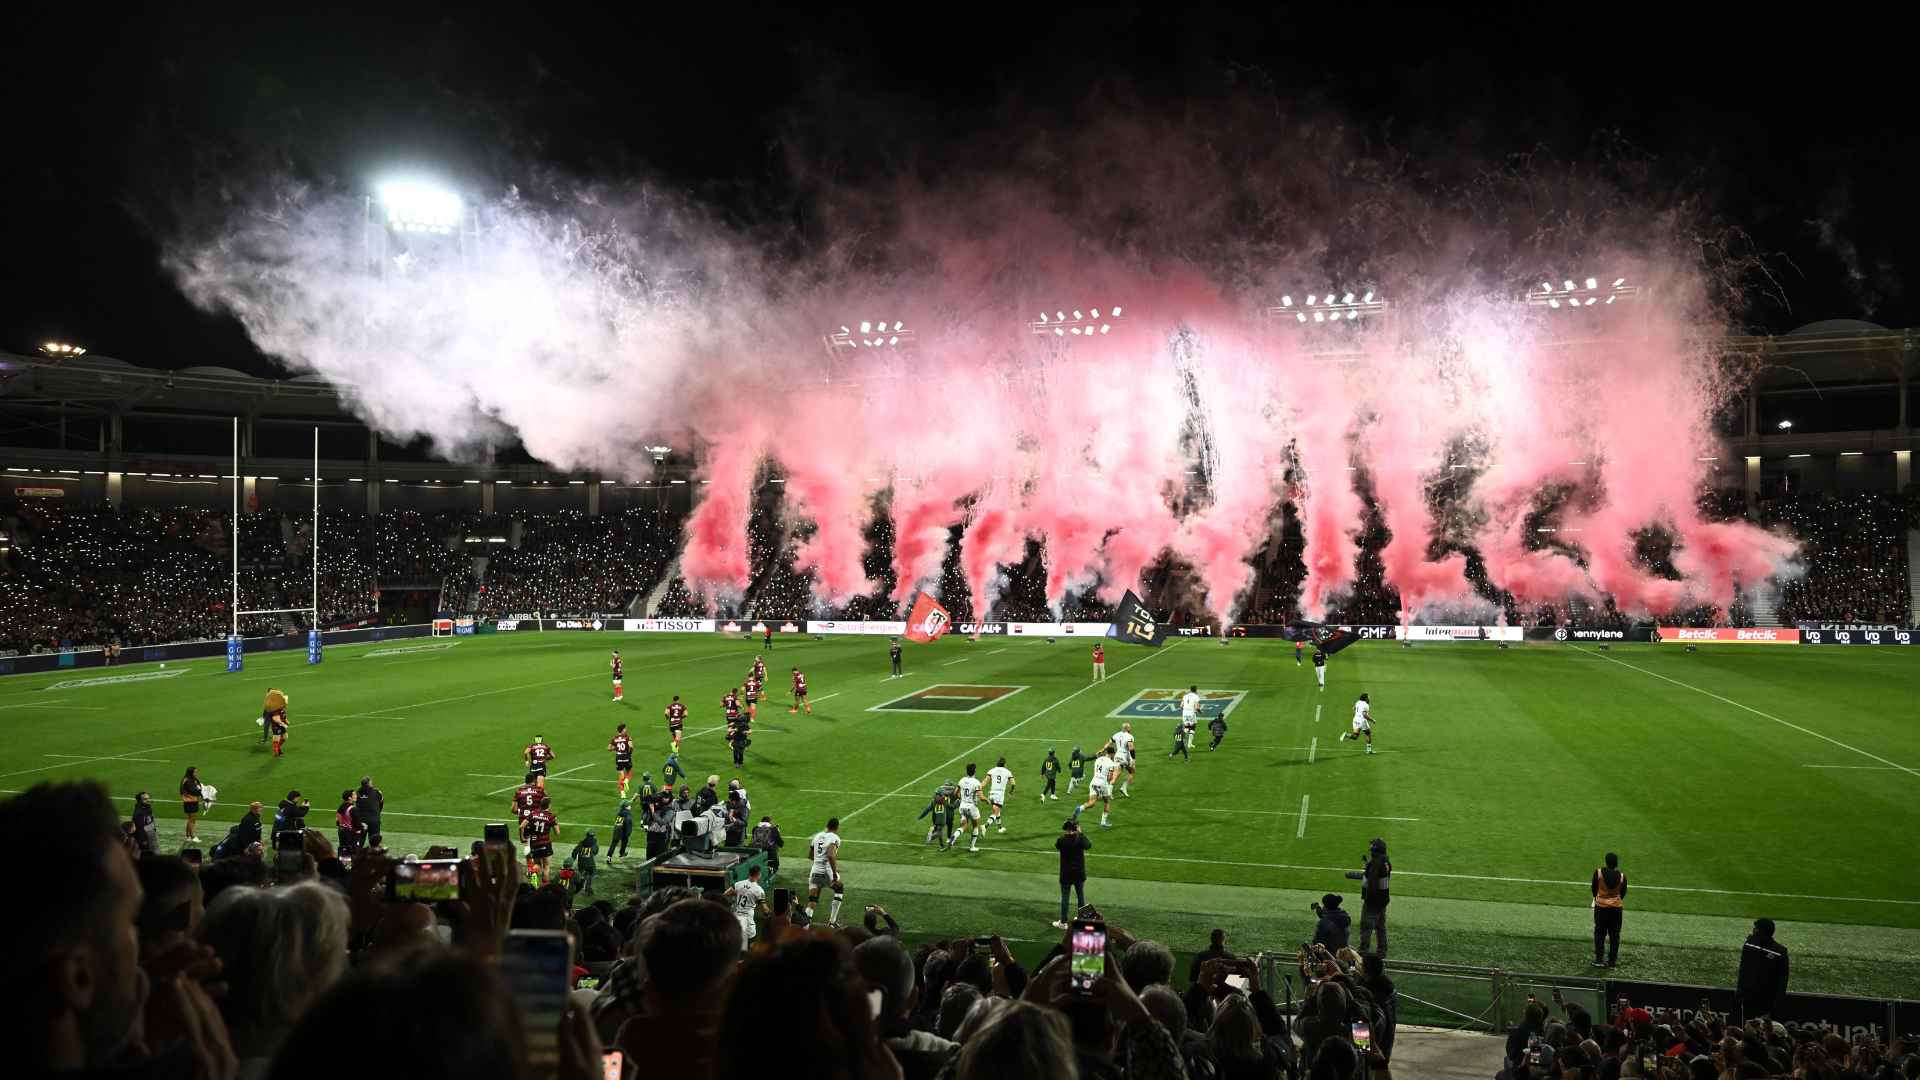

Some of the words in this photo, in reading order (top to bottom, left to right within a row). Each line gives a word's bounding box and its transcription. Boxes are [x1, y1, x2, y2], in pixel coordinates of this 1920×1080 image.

[655, 621, 702, 630] TISSOT
[838, 623, 898, 632] TotalEnergies
[1358, 627, 1387, 639] GMF
[1678, 629, 1718, 639] Betclic
[1737, 630, 1778, 640] Betclic
[617, 742, 626, 751] 10
[535, 749, 545, 757] 12
[996, 775, 1002, 784] 9
[526, 794, 534, 806] 5
[534, 821, 546, 833] 11
[817, 842, 824, 854] 5
[737, 894, 748, 908] 13
